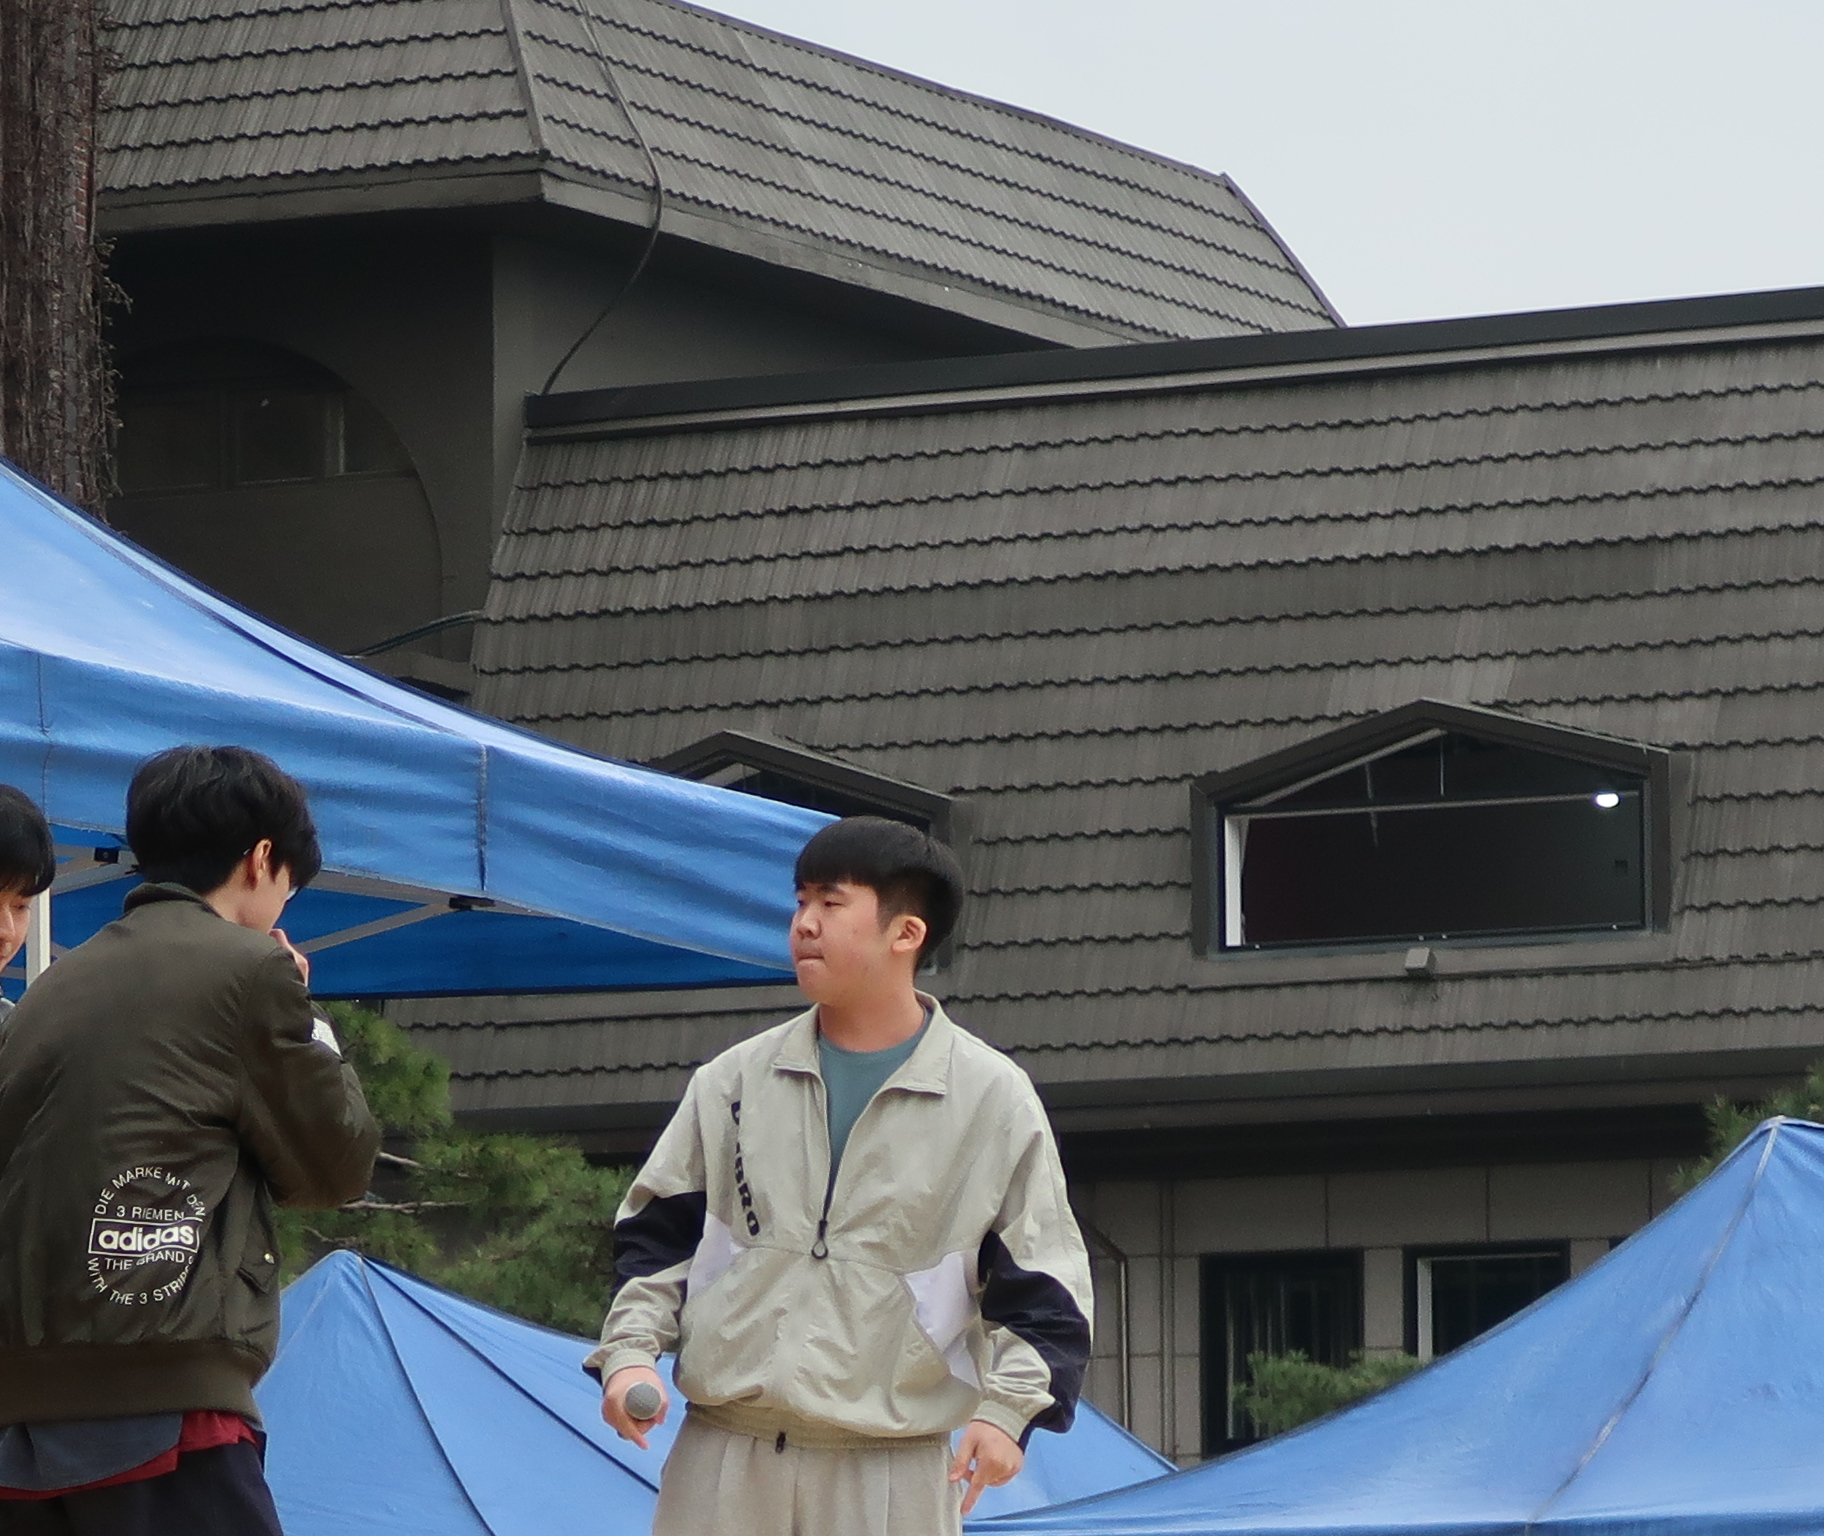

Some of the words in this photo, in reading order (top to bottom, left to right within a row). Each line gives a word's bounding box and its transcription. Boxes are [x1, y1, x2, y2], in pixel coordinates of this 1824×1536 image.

[731, 1100, 760, 1236] UBRO
[94, 1188, 115, 1215] DIE
[111, 1166, 163, 1190] MARKE
[116, 1205, 126, 1217] 3
[131, 1206, 185, 1221] RIEMEN
[98, 1225, 194, 1251] adidas
[104, 1257, 133, 1270] THE
[135, 1250, 185, 1266] BRAND
[87, 1257, 108, 1293] WITH
[109, 1289, 134, 1305] THE
[139, 1292, 148, 1305] 3
